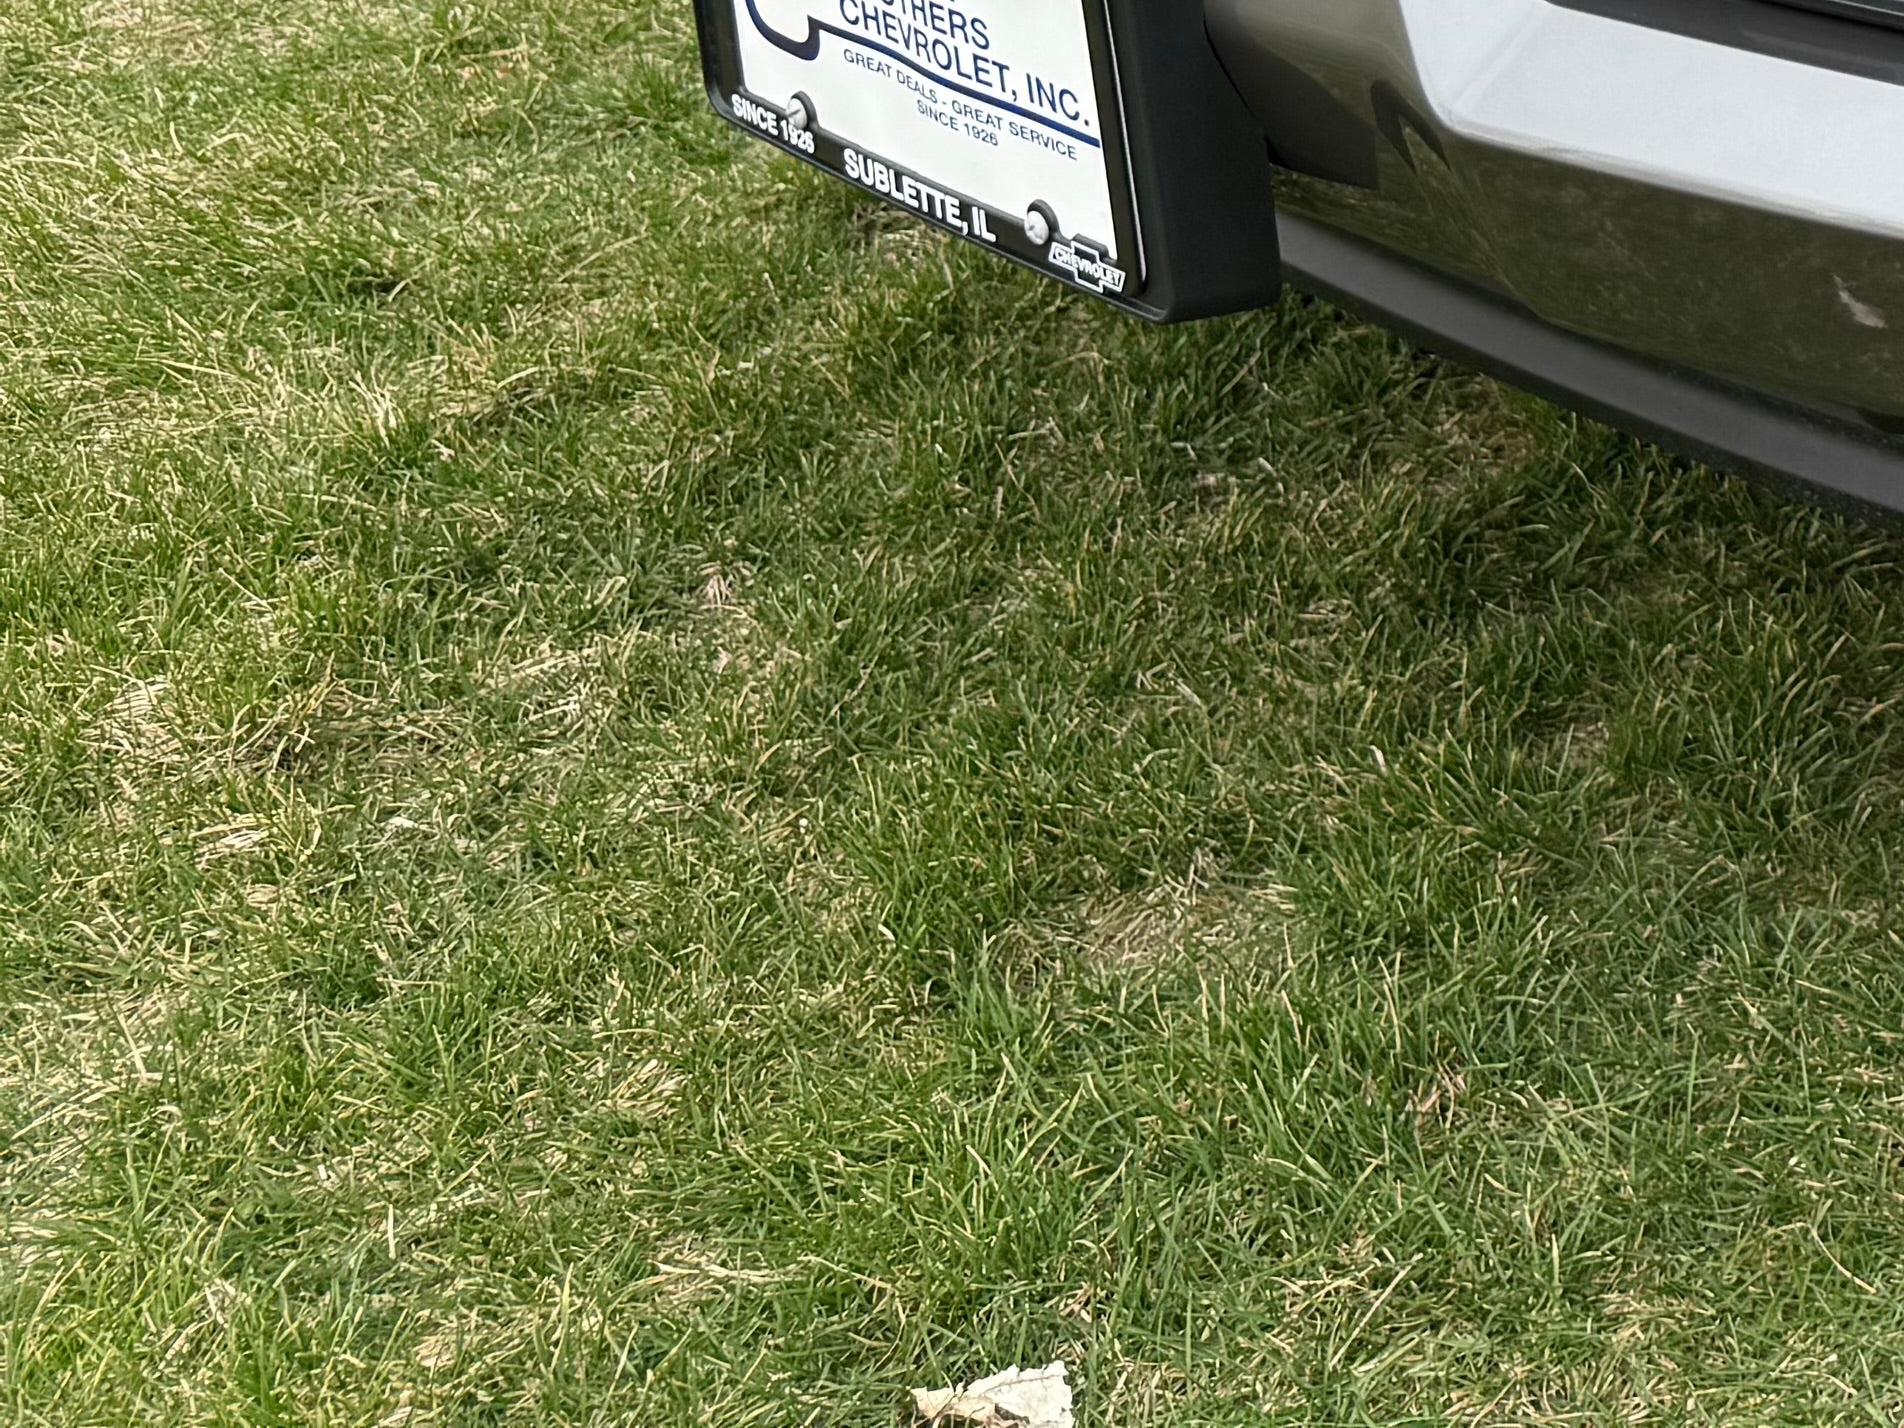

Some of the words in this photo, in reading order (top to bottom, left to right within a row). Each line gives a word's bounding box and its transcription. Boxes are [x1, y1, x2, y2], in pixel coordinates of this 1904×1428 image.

[731, 94, 779, 136] SINCE
[780, 119, 815, 154] 1926
[843, 48, 892, 78] GREAT
[896, 69, 938, 104] DEALS
[952, 100, 1003, 132] GREAT
[1009, 122, 1078, 161] SERVICE
[917, 99, 959, 132] SINCE
[964, 123, 999, 147] 1926
[1026, 73, 1090, 127] INC.
[843, 148, 969, 237] SUBLETTE,
[971, 206, 997, 243] IL
